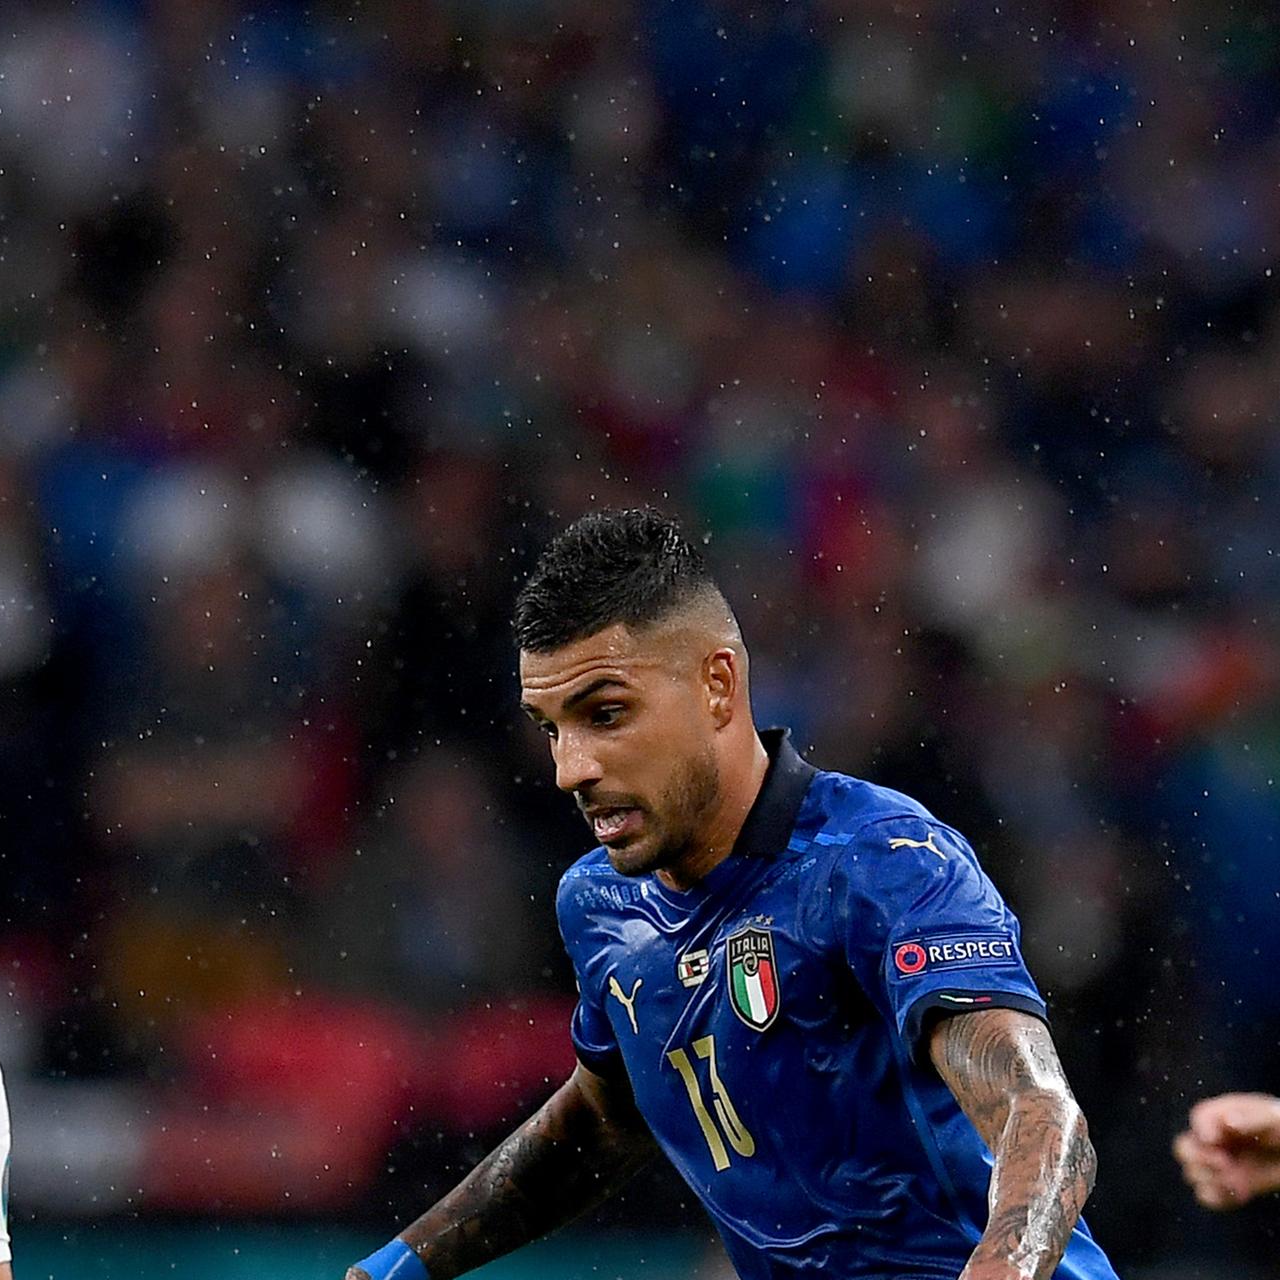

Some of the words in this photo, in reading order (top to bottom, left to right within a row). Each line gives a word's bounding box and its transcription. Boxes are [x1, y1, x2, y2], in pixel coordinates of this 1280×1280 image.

[731, 936, 769, 957] ITALIA
[928, 941, 1012, 963] RESPECT
[666, 1034, 755, 1172] 13
